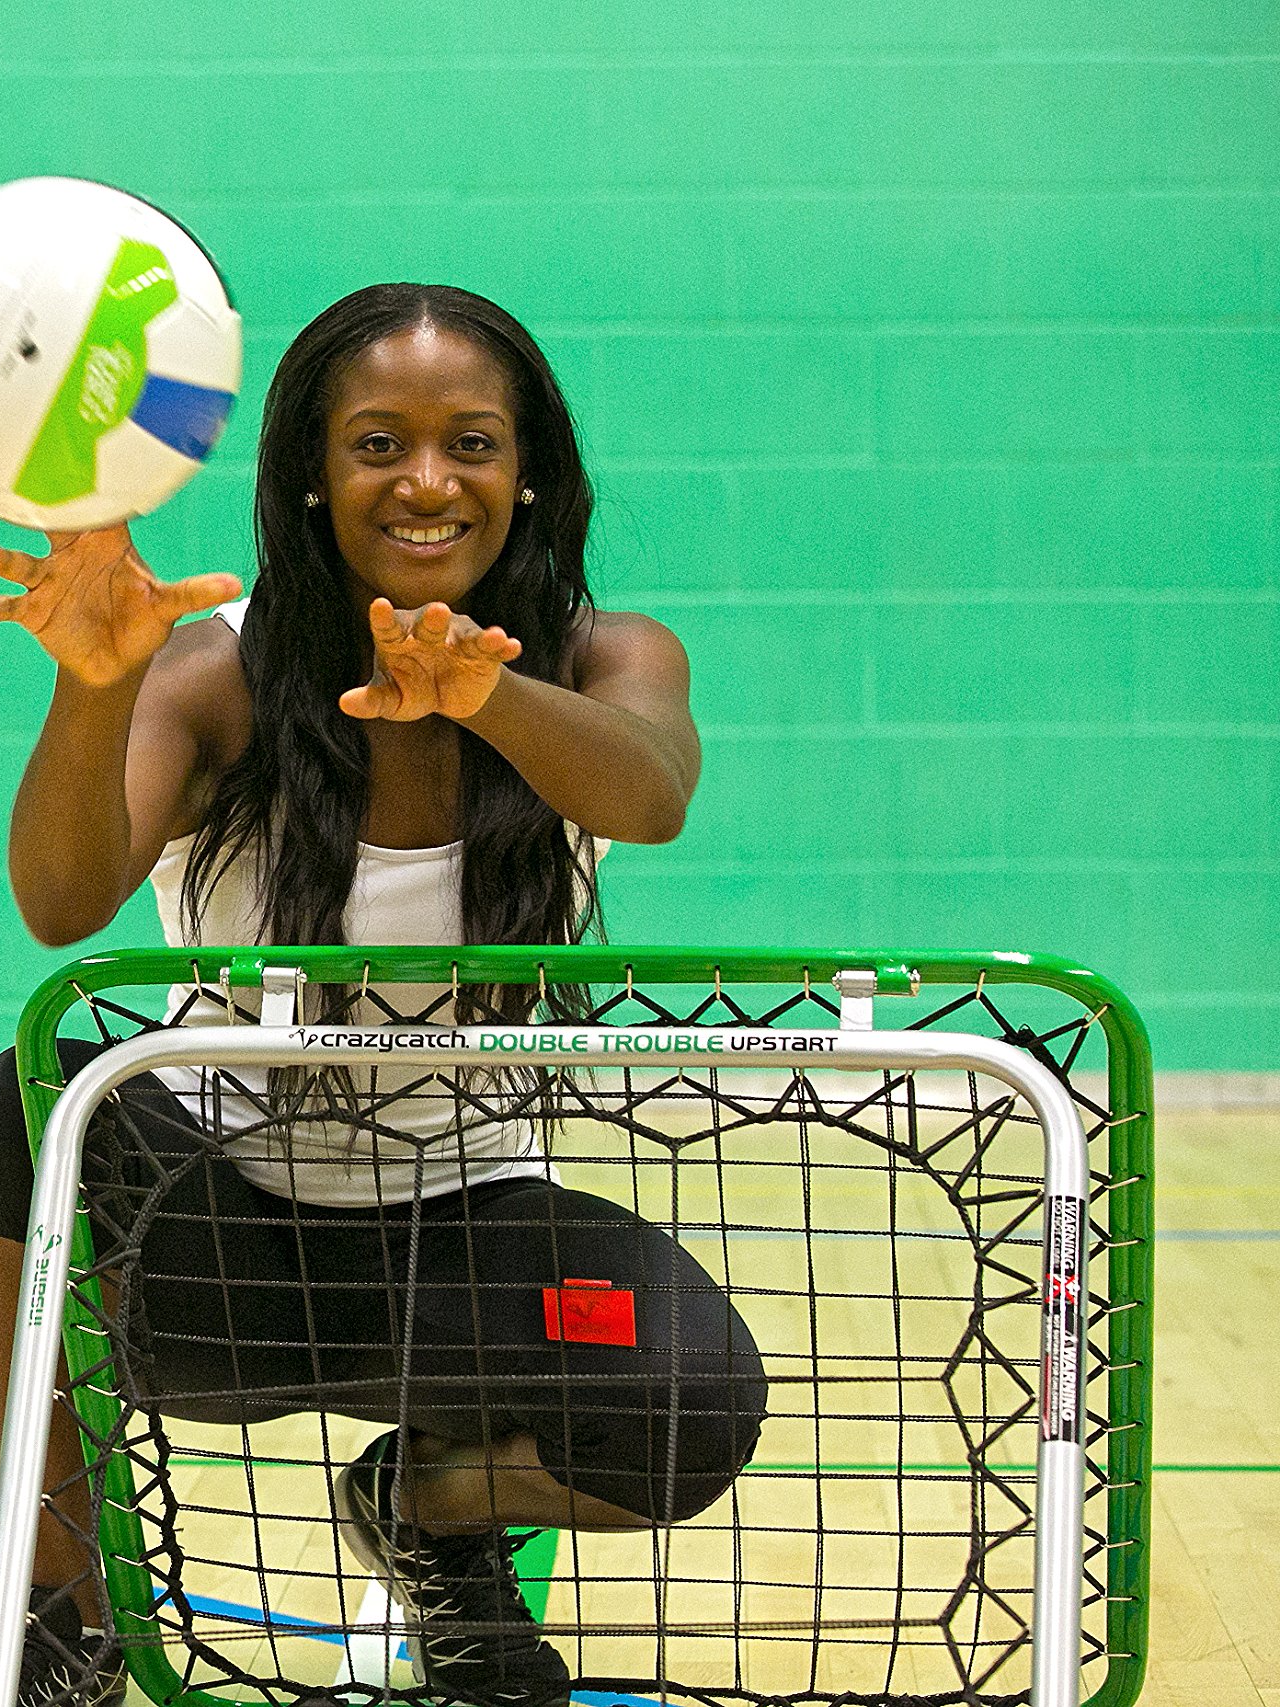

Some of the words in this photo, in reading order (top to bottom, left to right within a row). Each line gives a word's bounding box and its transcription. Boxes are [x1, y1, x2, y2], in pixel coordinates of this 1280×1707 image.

[479, 1033, 589, 1053] DOUBLE
[598, 1034, 724, 1054] TROUBLE
[1064, 1201, 1077, 1270] WARNING
[28, 1258, 50, 1327] insane
[1061, 1347, 1077, 1422] WARNING
